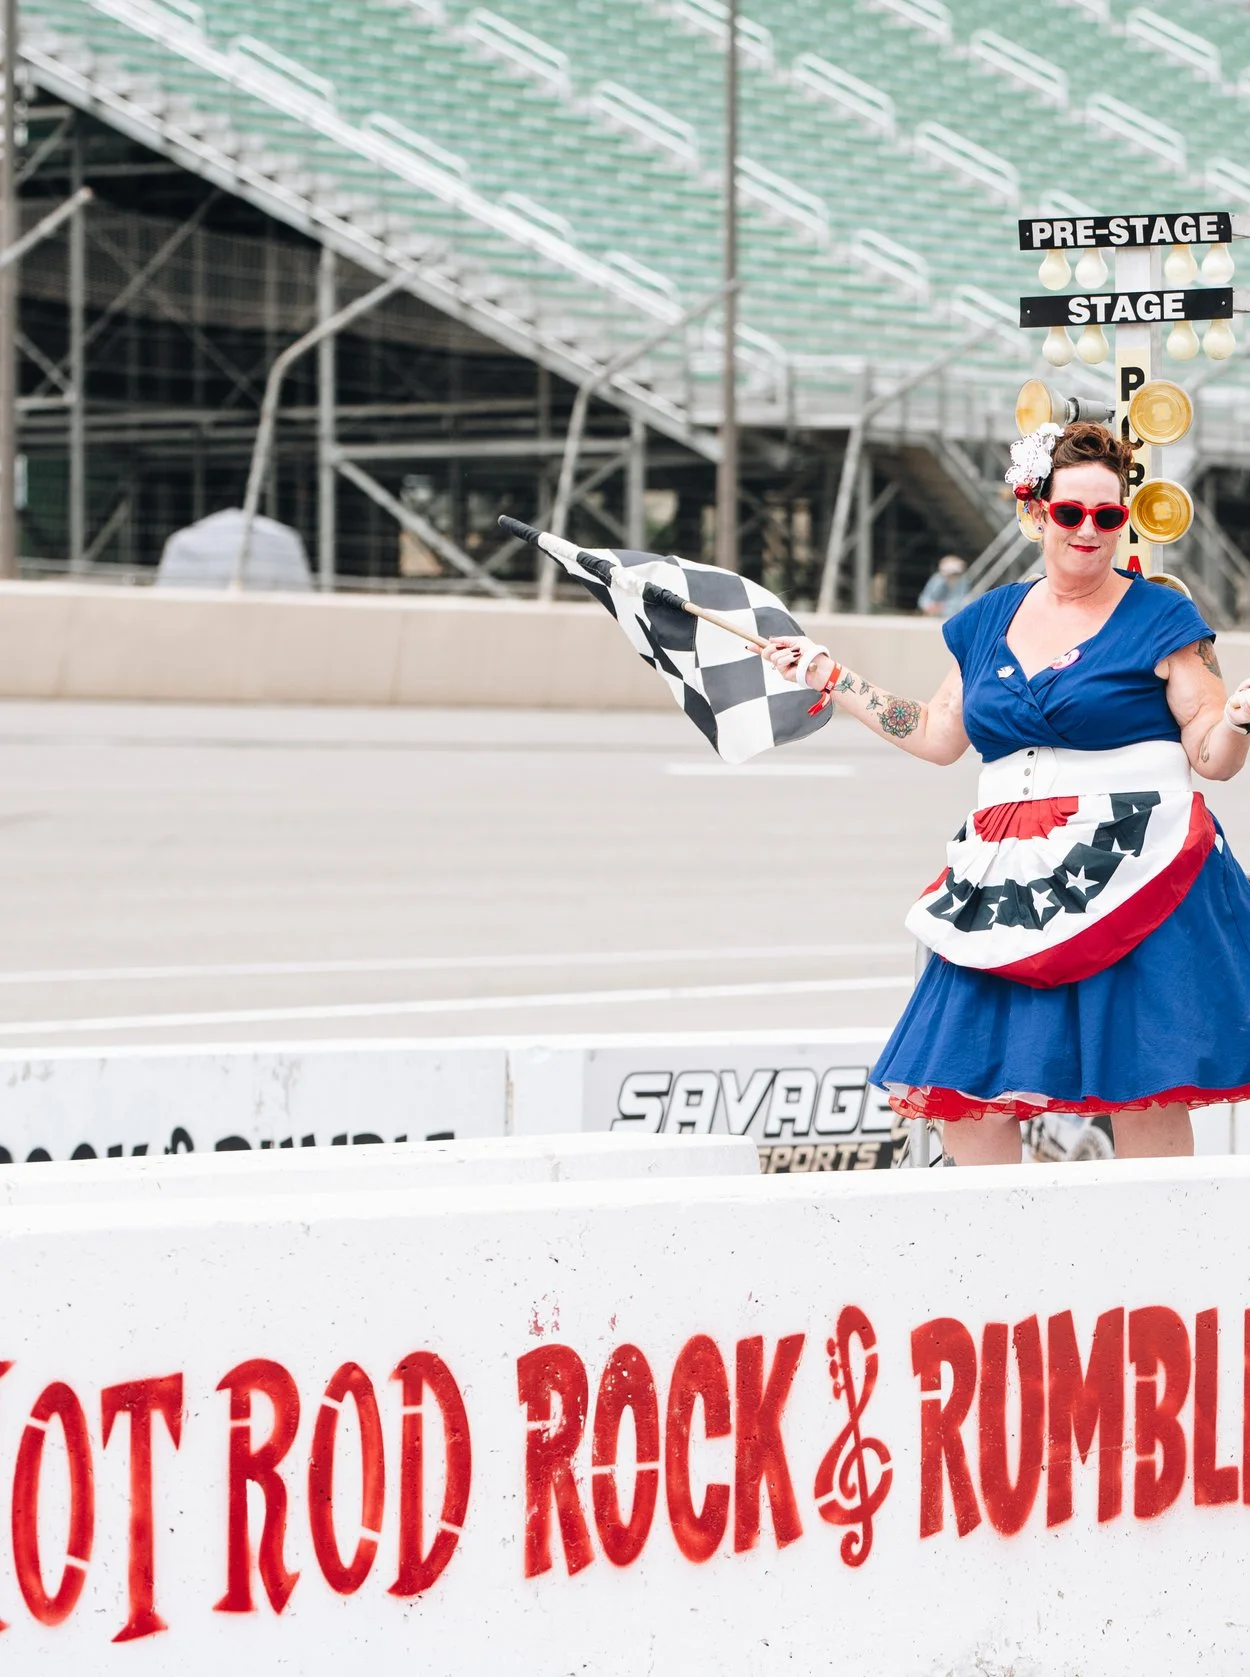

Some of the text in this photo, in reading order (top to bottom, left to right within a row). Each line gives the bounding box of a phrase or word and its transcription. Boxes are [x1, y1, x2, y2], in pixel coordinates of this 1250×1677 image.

[1031, 215, 1220, 247] PRE-STAGE
[1067, 293, 1185, 323] STAGE
[0, 1361, 185, 1644] OT
[213, 1351, 473, 1617] ROD
[516, 1333, 806, 1580] ROCK
